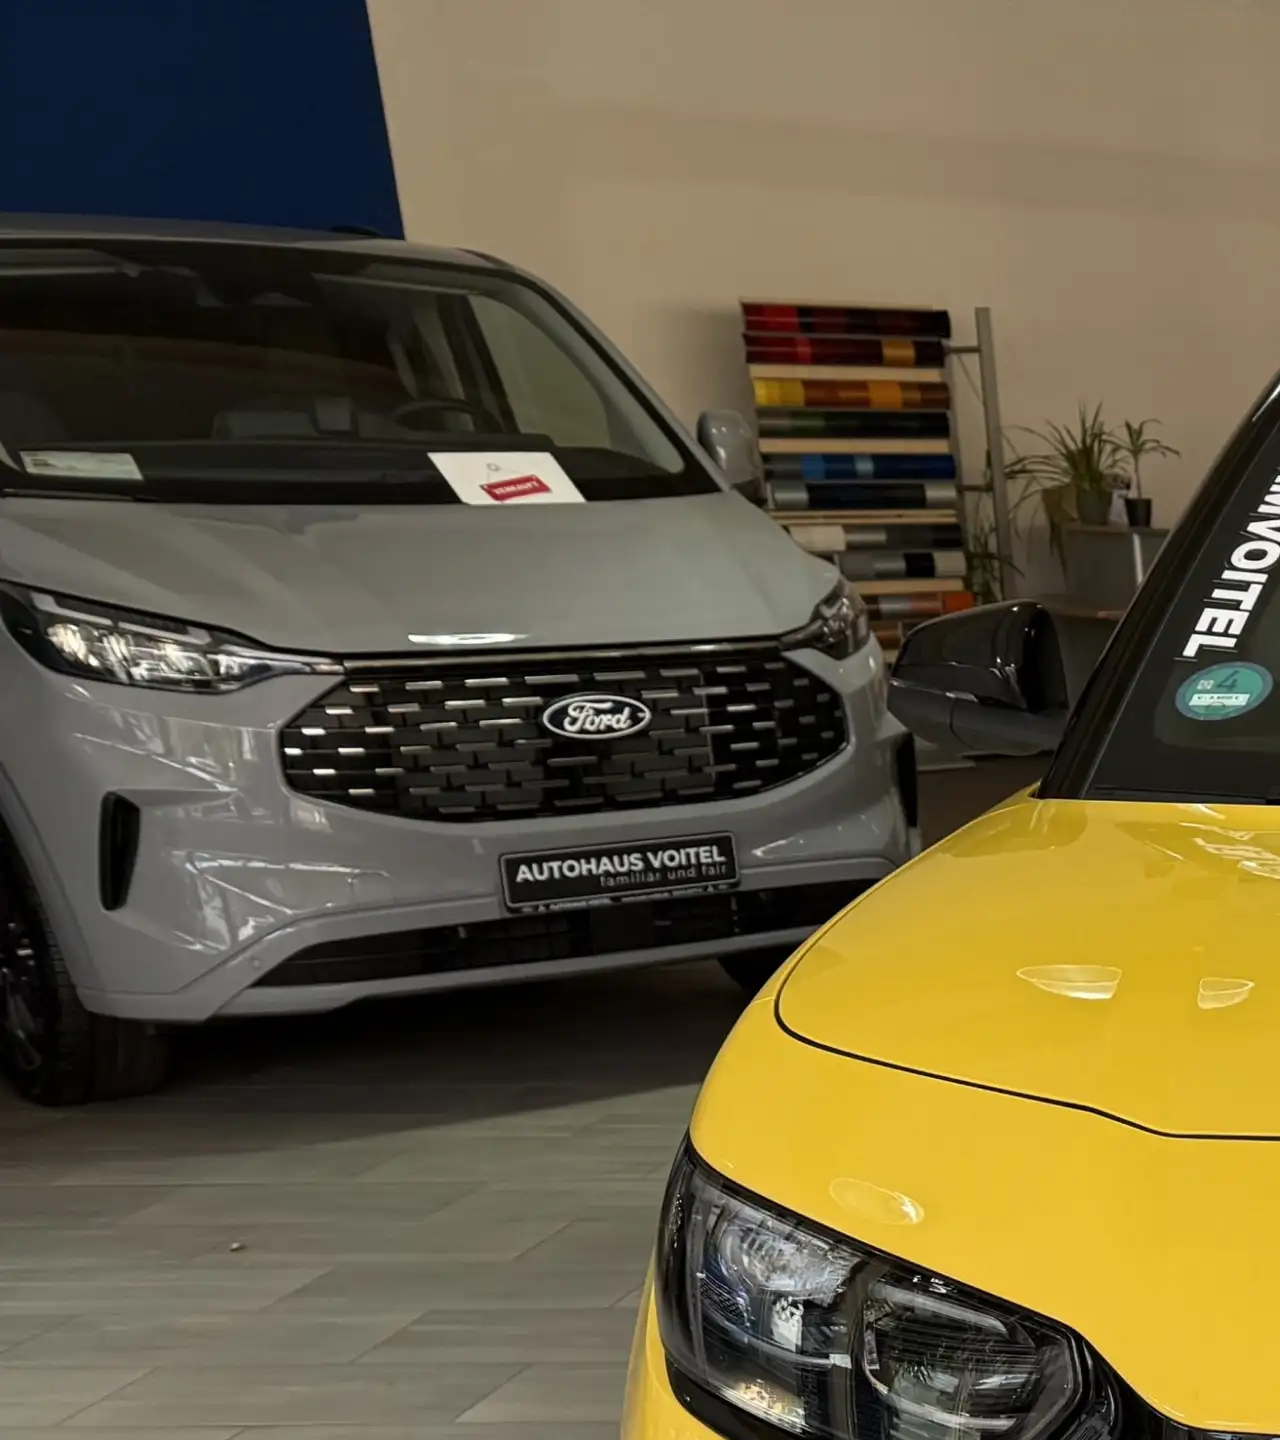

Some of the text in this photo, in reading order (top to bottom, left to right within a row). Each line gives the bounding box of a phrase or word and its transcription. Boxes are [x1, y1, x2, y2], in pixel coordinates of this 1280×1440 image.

[1215, 669, 1240, 692] 4
[563, 701, 632, 733] Ford
[515, 845, 728, 883] AUTOHAUS VOITEL
[667, 864, 696, 880] und
[701, 862, 728, 876] fair
